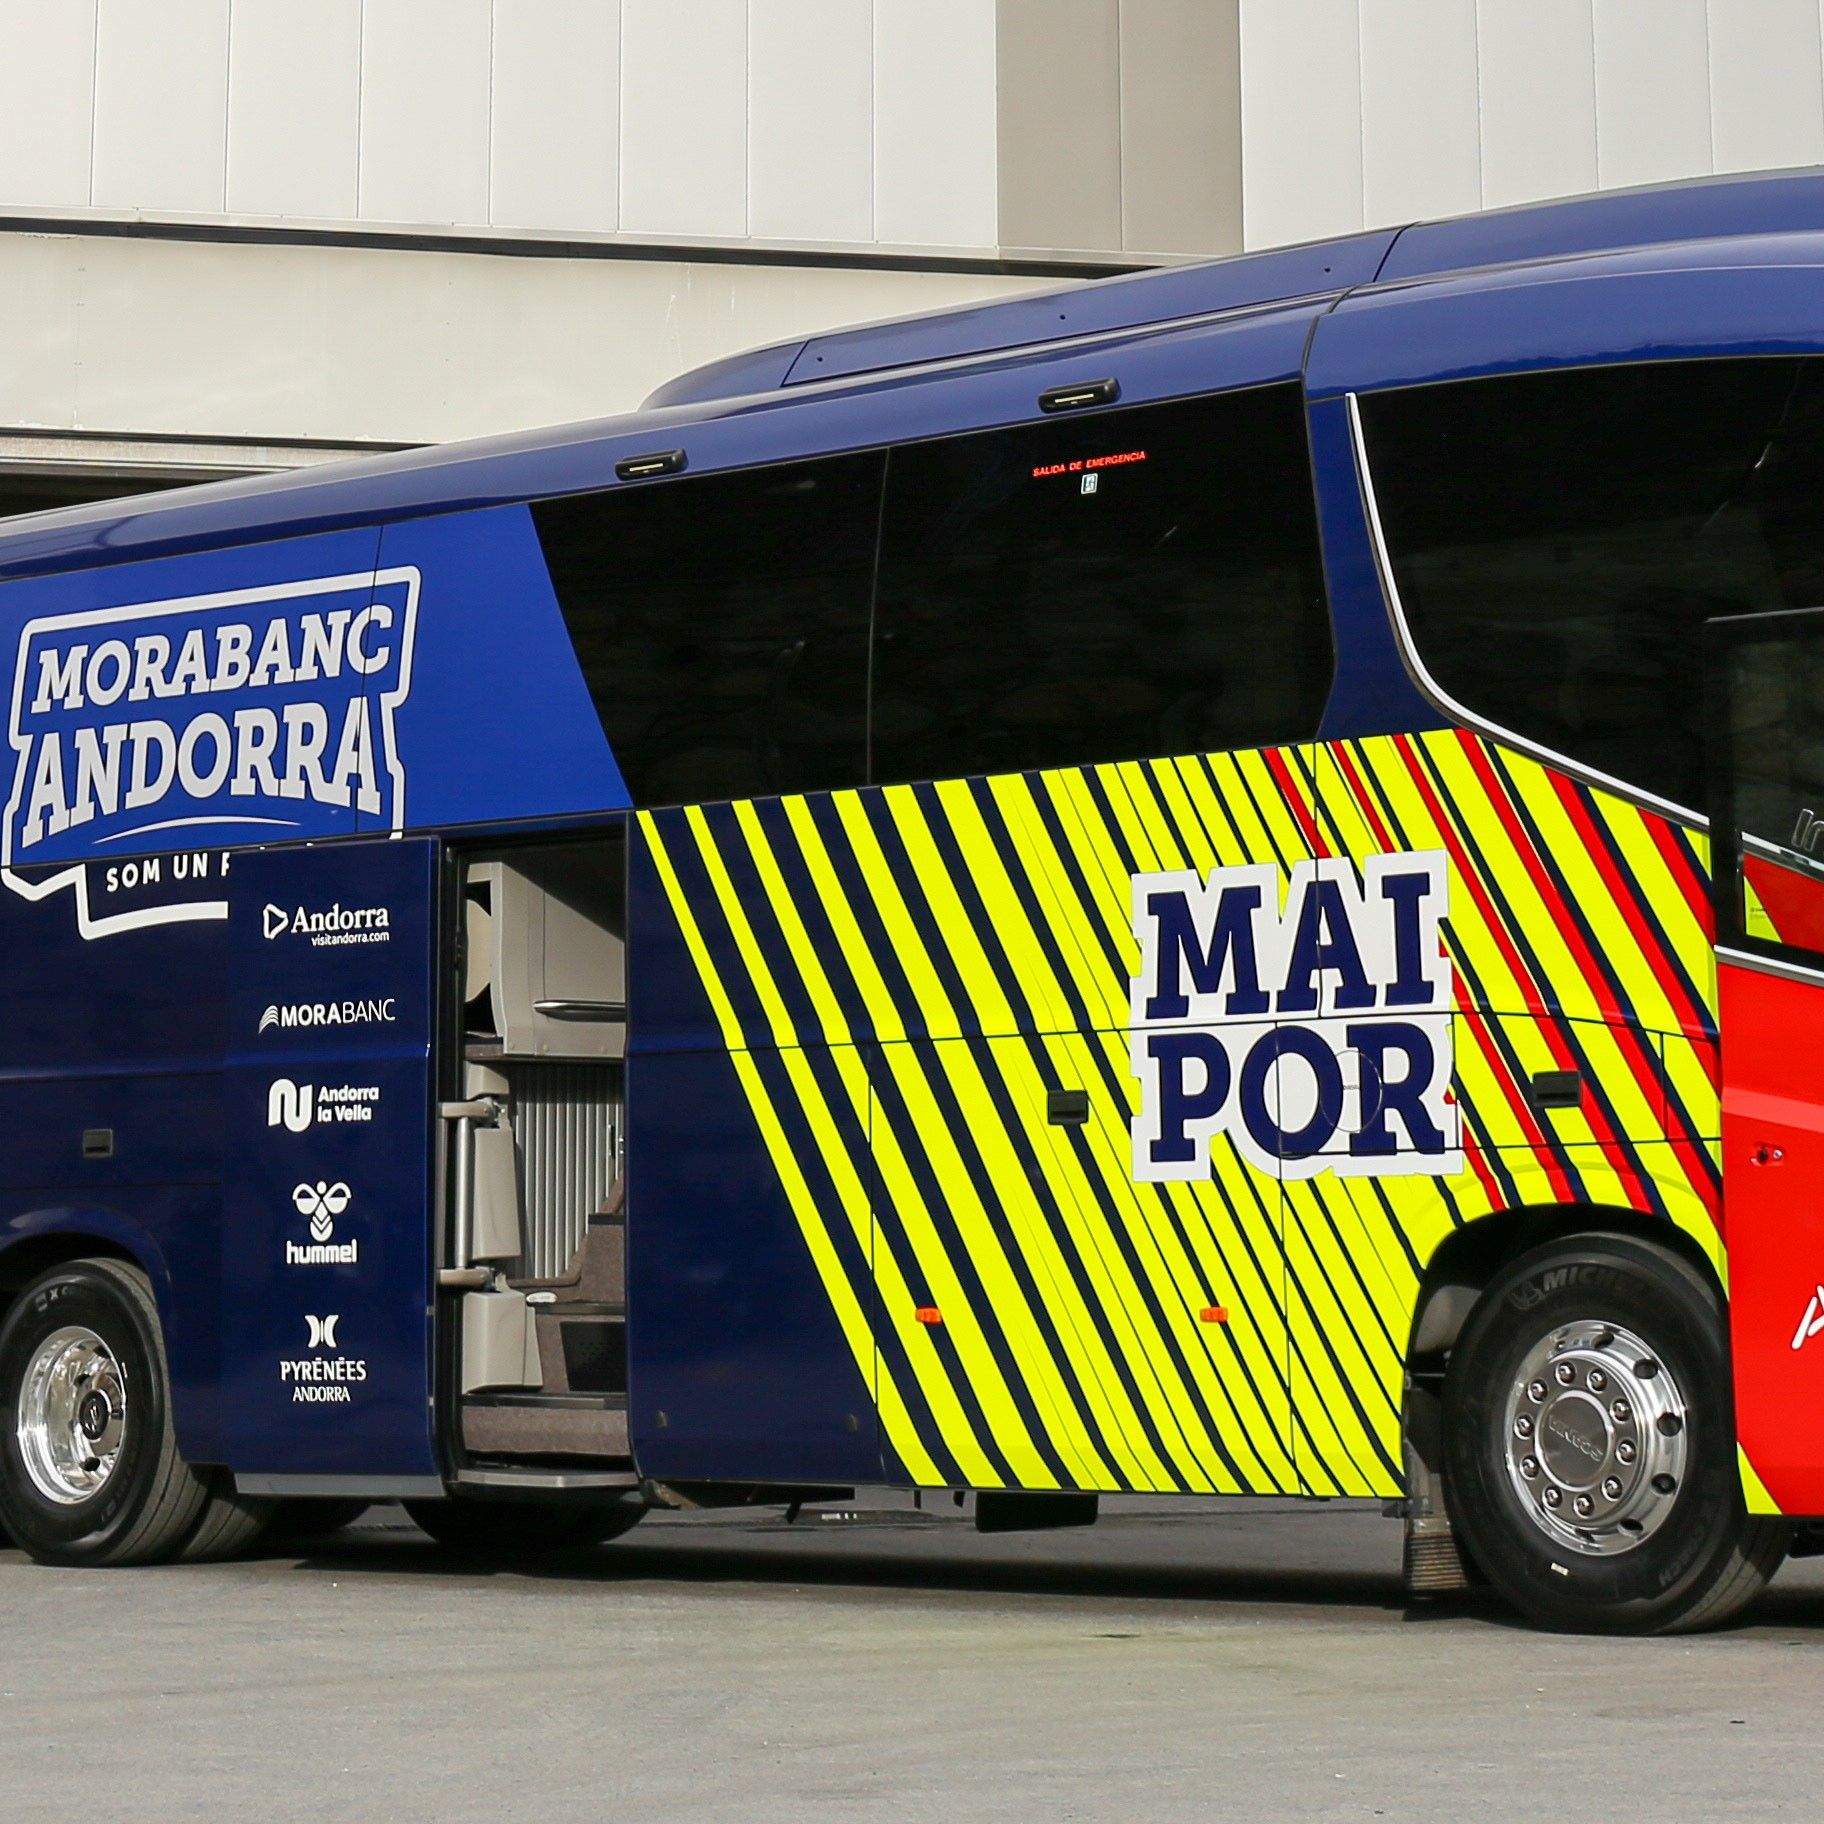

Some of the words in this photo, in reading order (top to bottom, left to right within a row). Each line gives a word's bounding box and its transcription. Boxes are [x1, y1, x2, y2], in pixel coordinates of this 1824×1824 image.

[1032, 464, 1066, 478] SALIDA
[1069, 460, 1083, 472] DE
[1086, 450, 1147, 469] EMERGENCIA
[30, 603, 394, 714] MORABANC
[22, 695, 382, 849] ANDORRA
[106, 858, 161, 893] SOM
[173, 852, 209, 880] UN
[290, 903, 390, 933] Andorra
[311, 930, 390, 946] visitandorra.com
[1145, 871, 1435, 1020] MAI
[281, 998, 396, 1027] MORABANC
[318, 1084, 380, 1103] Andorra
[1147, 1021, 1446, 1163] POR
[317, 1106, 332, 1122] la
[335, 1104, 372, 1122] Vella
[286, 1238, 358, 1265] hummel
[292, 1386, 351, 1402] ANDORRA
